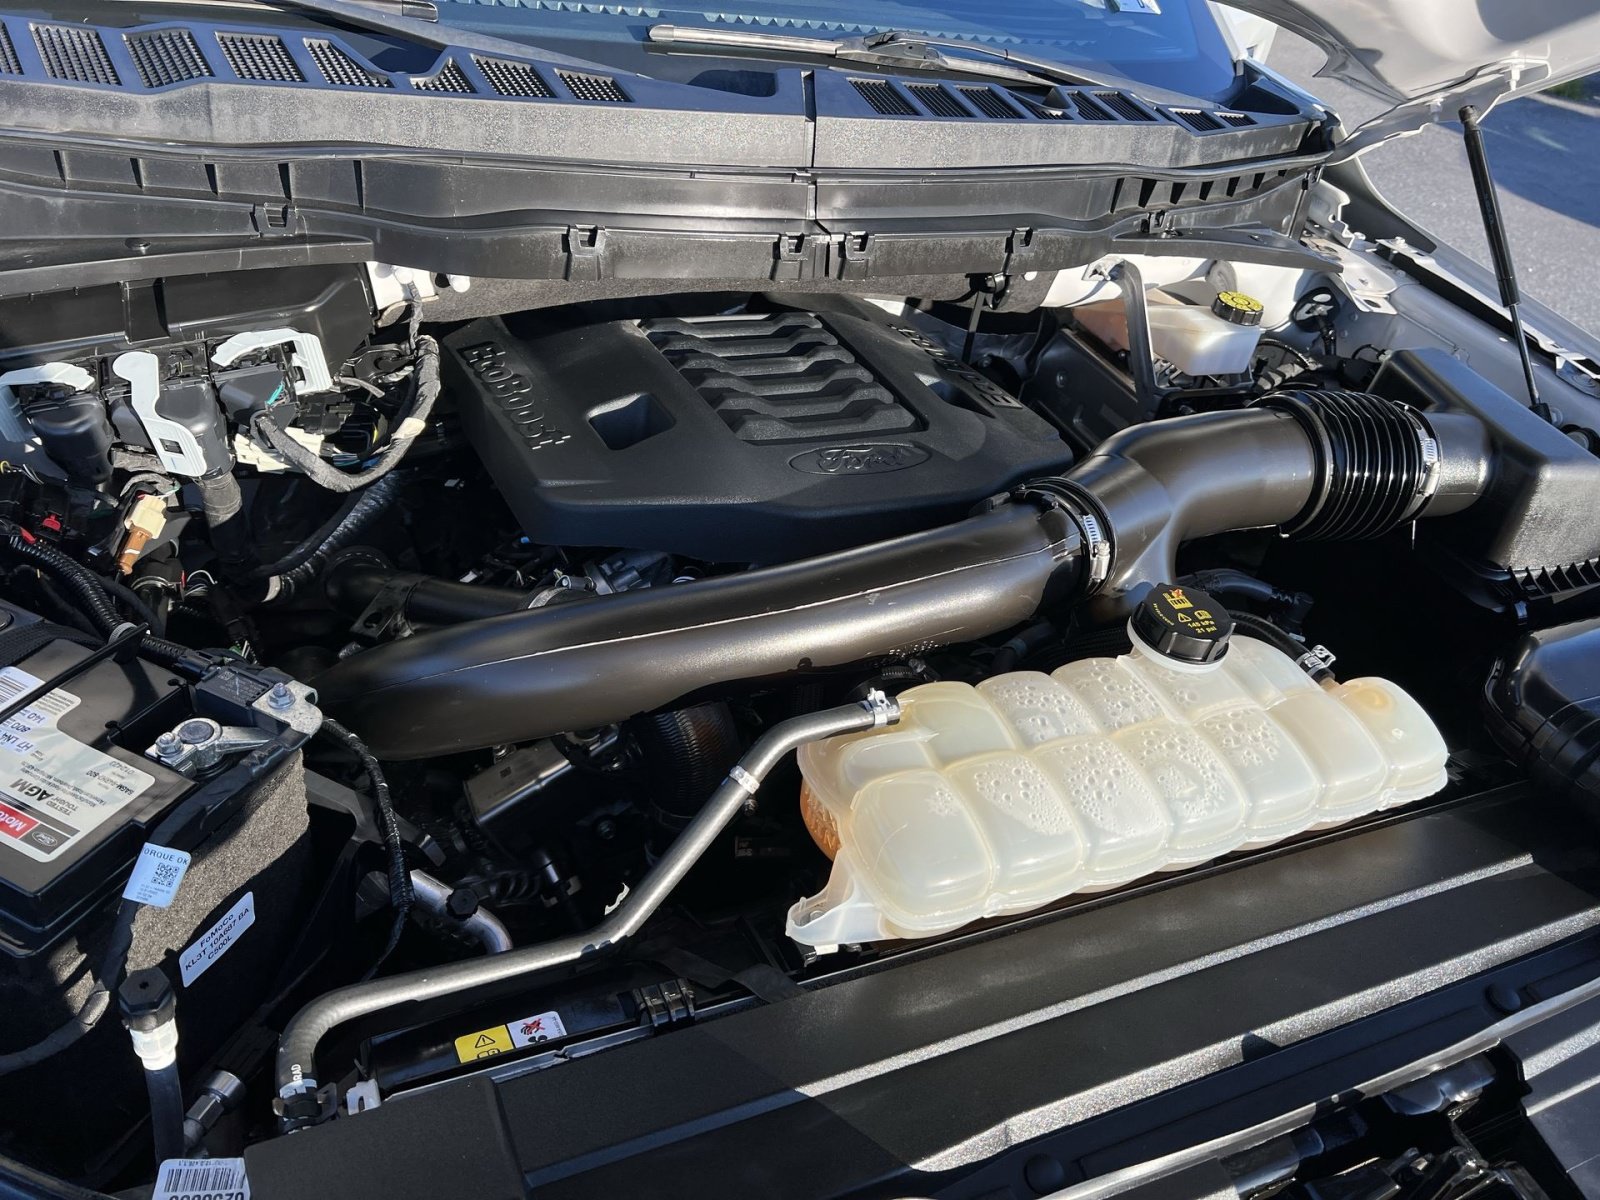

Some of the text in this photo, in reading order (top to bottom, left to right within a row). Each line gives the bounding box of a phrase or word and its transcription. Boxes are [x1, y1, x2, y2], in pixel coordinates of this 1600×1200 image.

[462, 341, 571, 451] EcoBoost
[816, 447, 904, 473] Ford
[9, 778, 54, 802] AGM
[46, 800, 73, 816] TESTED
[143, 848, 189, 866] ORQUE OK
[185, 949, 207, 971] KL3T
[238, 907, 250, 921] BA
[200, 913, 234, 947] FoMoCo
